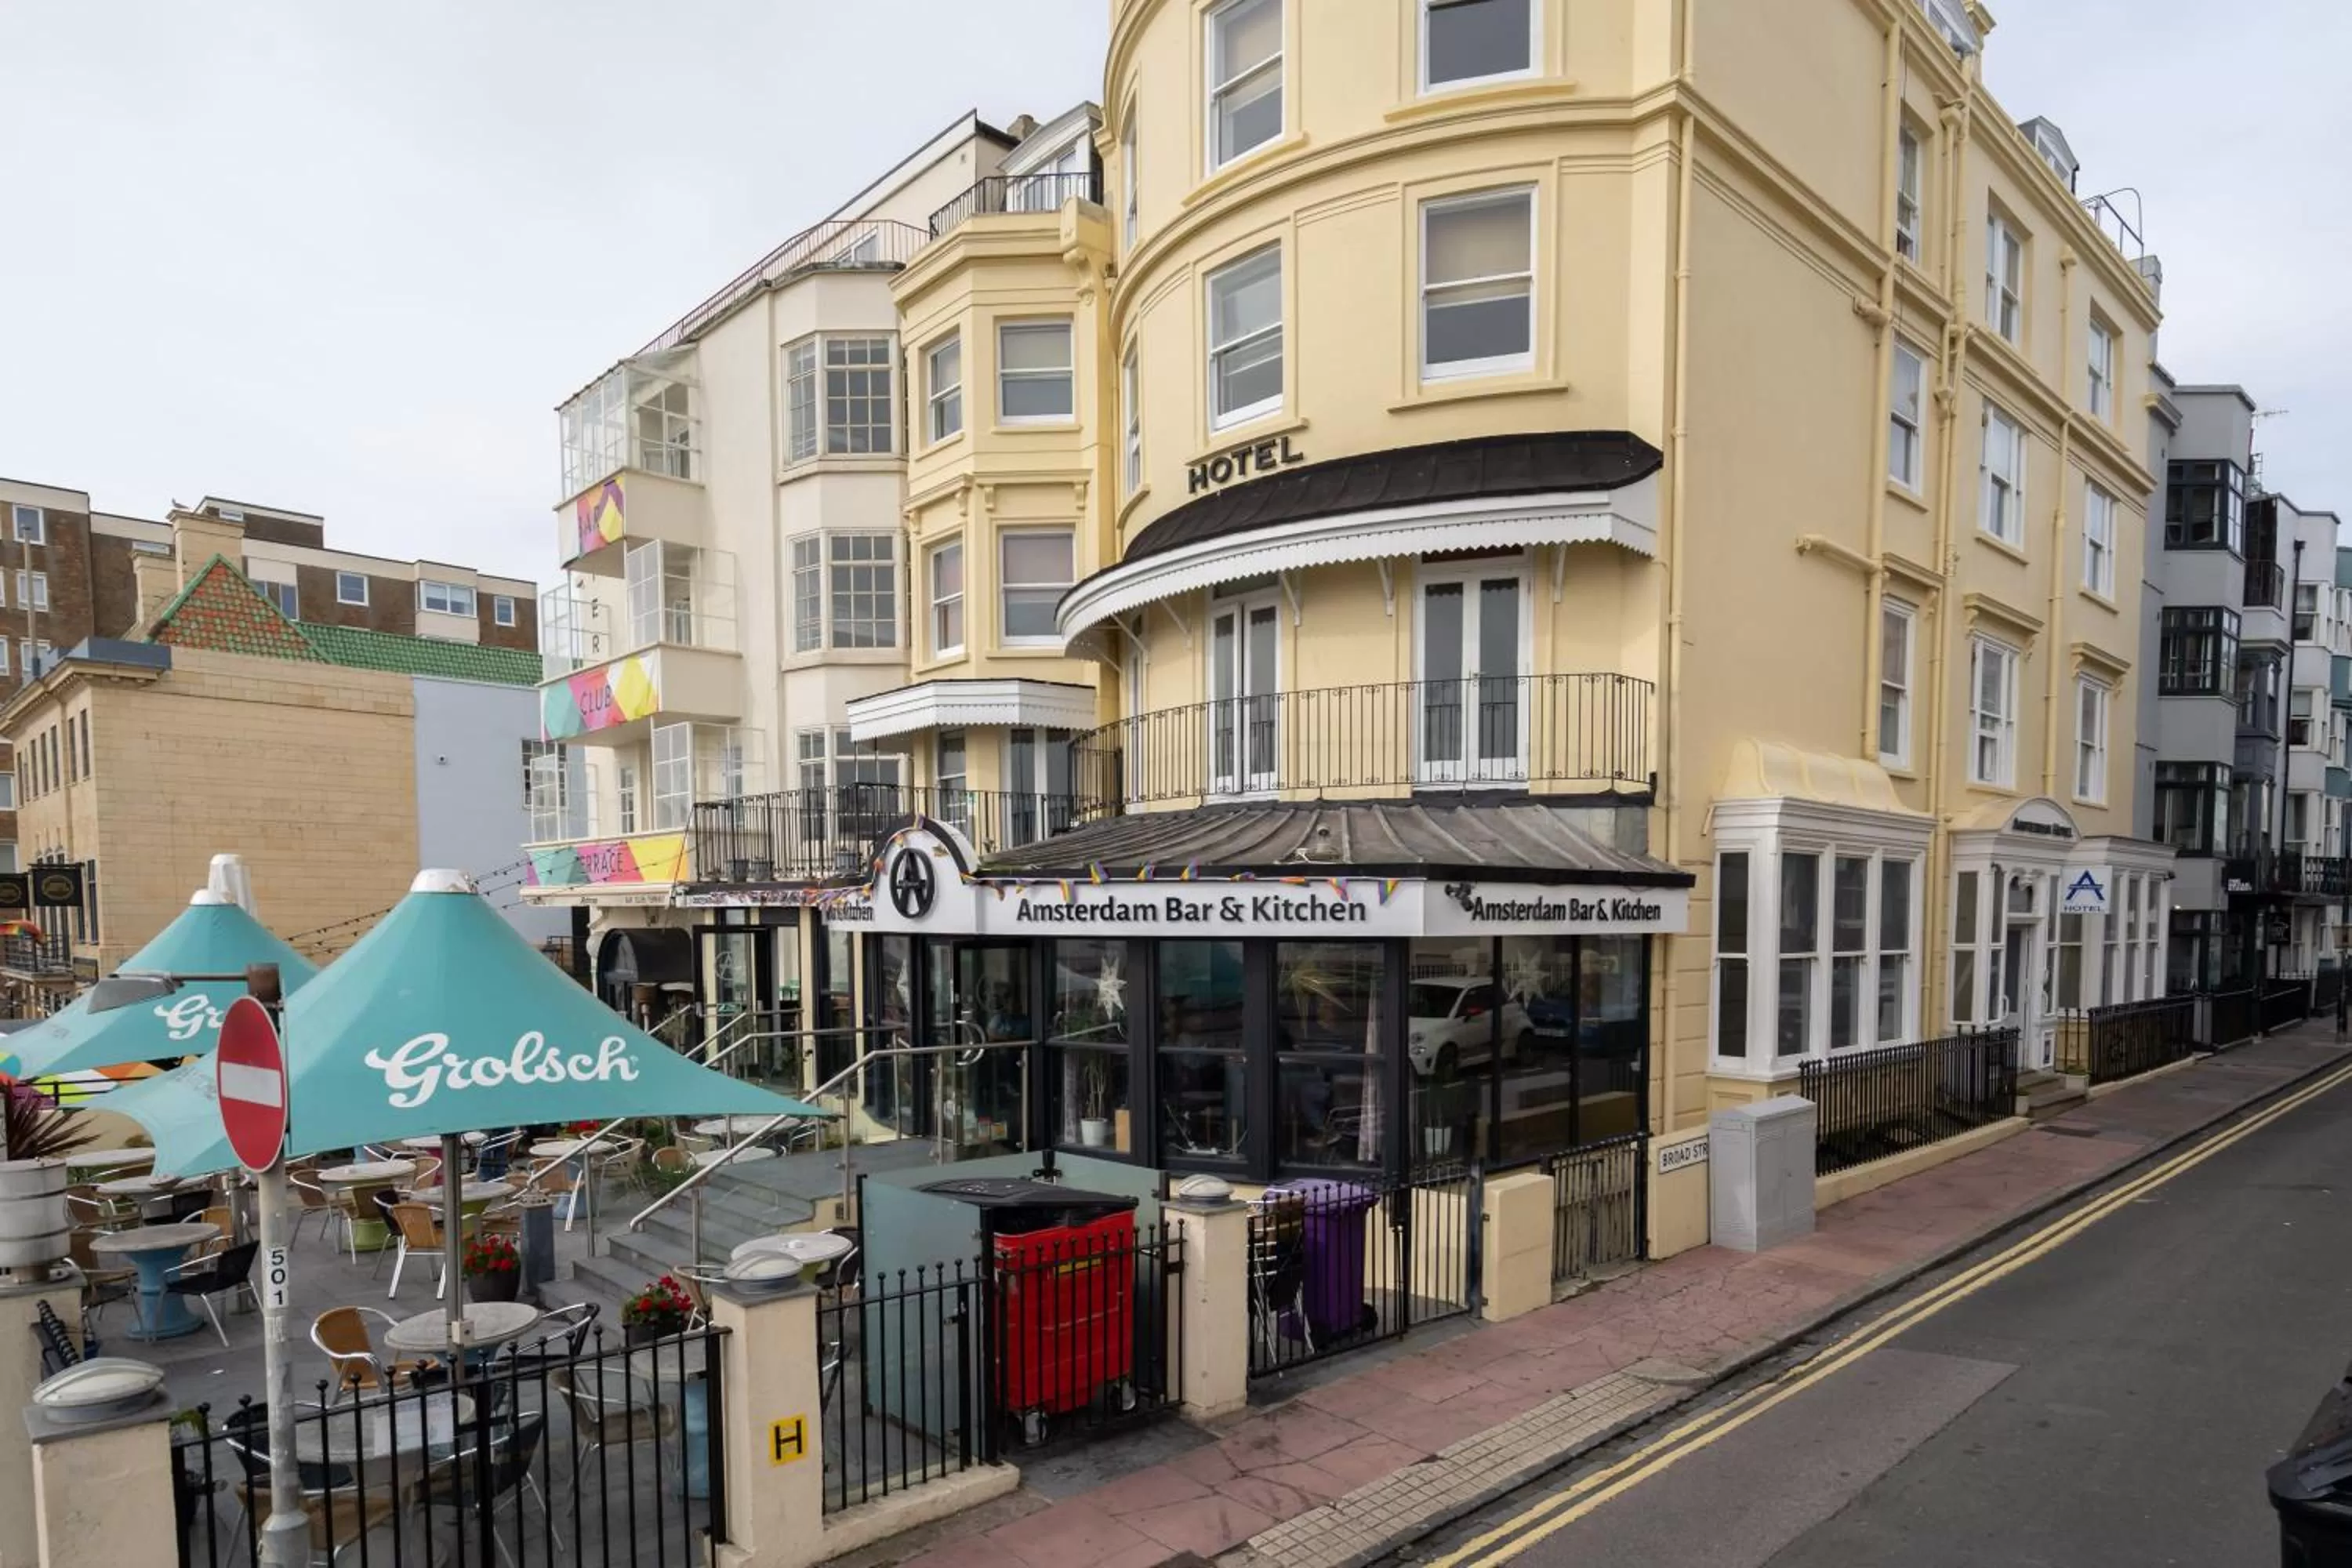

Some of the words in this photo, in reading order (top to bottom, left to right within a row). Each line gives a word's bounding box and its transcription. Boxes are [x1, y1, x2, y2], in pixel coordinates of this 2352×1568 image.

[1189, 436, 1305, 494] HOTEL
[581, 684, 612, 715] CLUB
[1016, 895, 1157, 922] Amsterdam
[1165, 896, 1213, 922] Bar
[1220, 895, 1244, 922] &
[1252, 894, 1367, 922] Kitchen
[1472, 895, 1566, 921] Amsterdam
[1570, 898, 1595, 921] Bar
[1597, 898, 1610, 921] &
[1611, 897, 1661, 921] Kitchen
[365, 1031, 639, 1108] Grolsch
[775, 1419, 803, 1461] H
